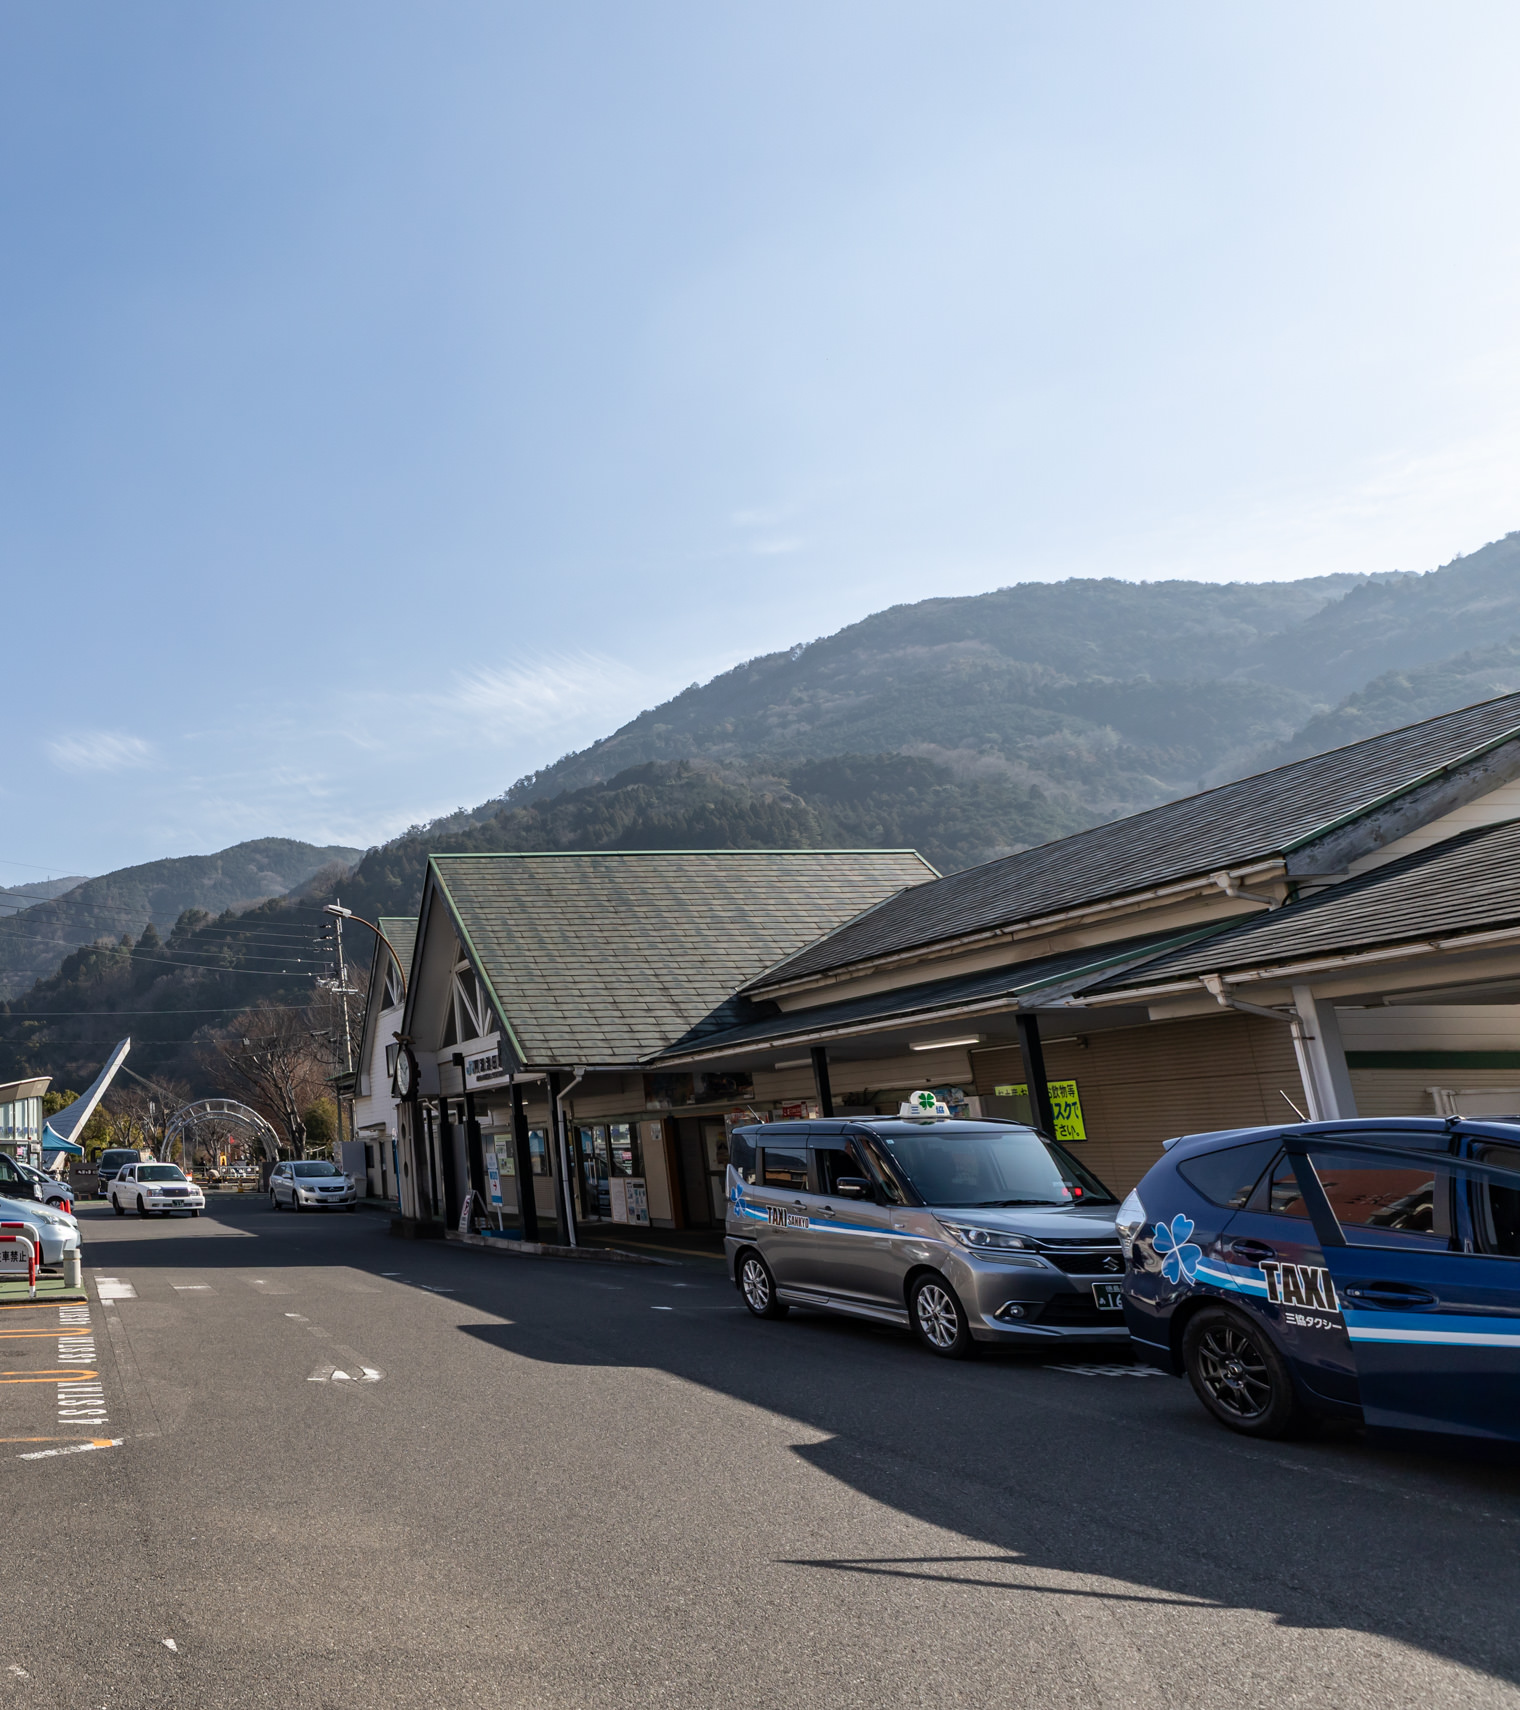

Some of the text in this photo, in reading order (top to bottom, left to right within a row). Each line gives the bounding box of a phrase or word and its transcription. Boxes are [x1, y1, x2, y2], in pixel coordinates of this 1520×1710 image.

[1052, 1101, 1079, 1120] スクで
[766, 1205, 809, 1229] TAXI SANKYO
[1258, 1261, 1339, 1313] TAXI
[1285, 1312, 1342, 1330] 三協タクシー
